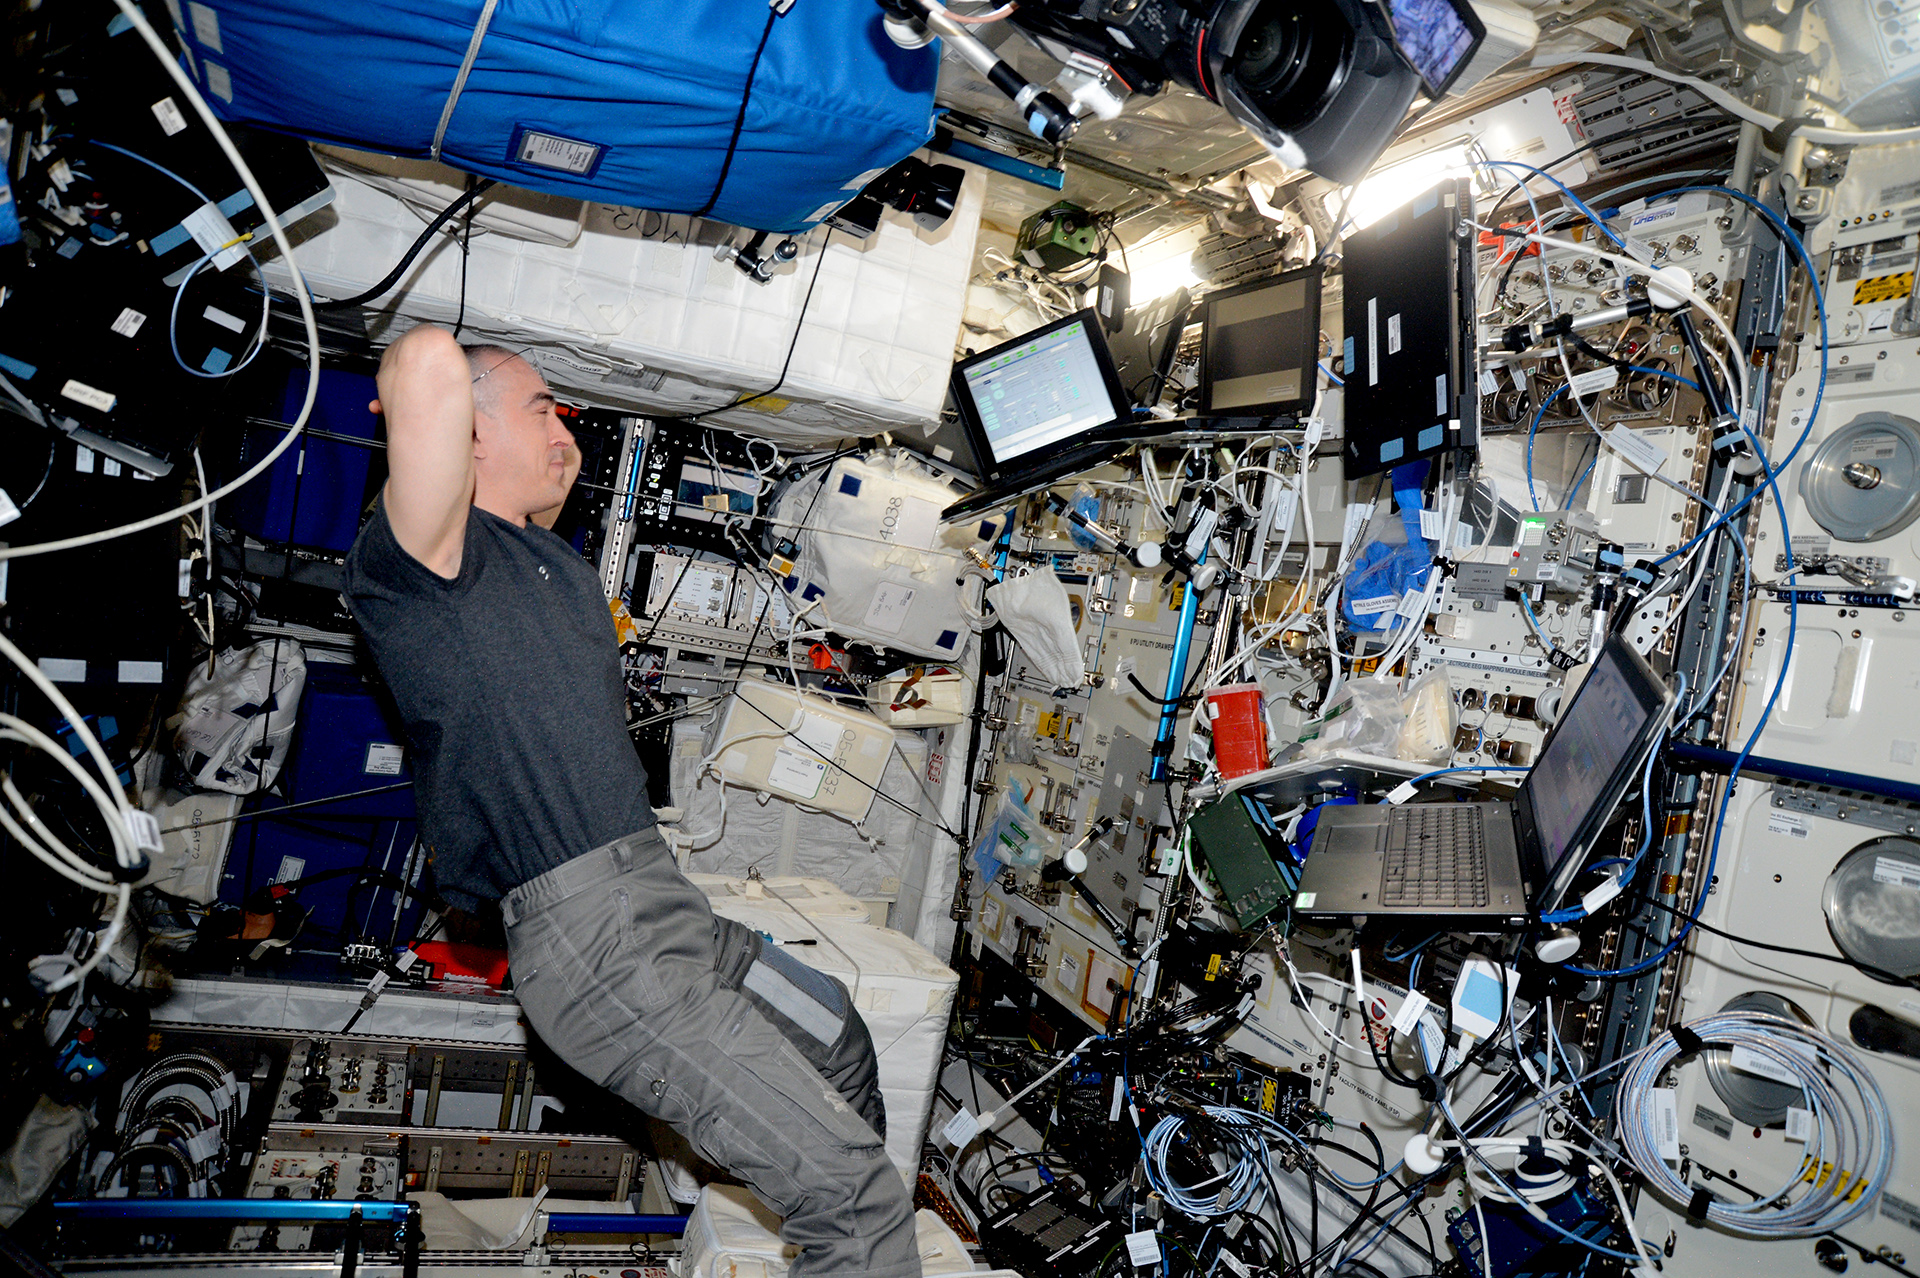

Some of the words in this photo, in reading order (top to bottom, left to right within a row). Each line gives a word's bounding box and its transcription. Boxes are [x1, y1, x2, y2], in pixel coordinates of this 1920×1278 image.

[1654, 210, 1675, 222] SYSTEM
[1480, 252, 1497, 263] EPM
[879, 497, 903, 540] 4038
[1139, 639, 1155, 648] UTILITY
[1482, 664, 1504, 673] MAPPING
[1505, 667, 1526, 676] MODULE
[823, 729, 857, 796] 05-5237
[1095, 903, 1118, 929] Manfrotto
[1374, 980, 1389, 990] DATA
[1387, 985, 1408, 999] MANAGE
[1337, 1076, 1358, 1091] FACILITY
[1355, 1087, 1376, 1102] SERVICE
[1373, 1097, 1390, 1110] PANEL
[1387, 1106, 1401, 1118] (FSP)
